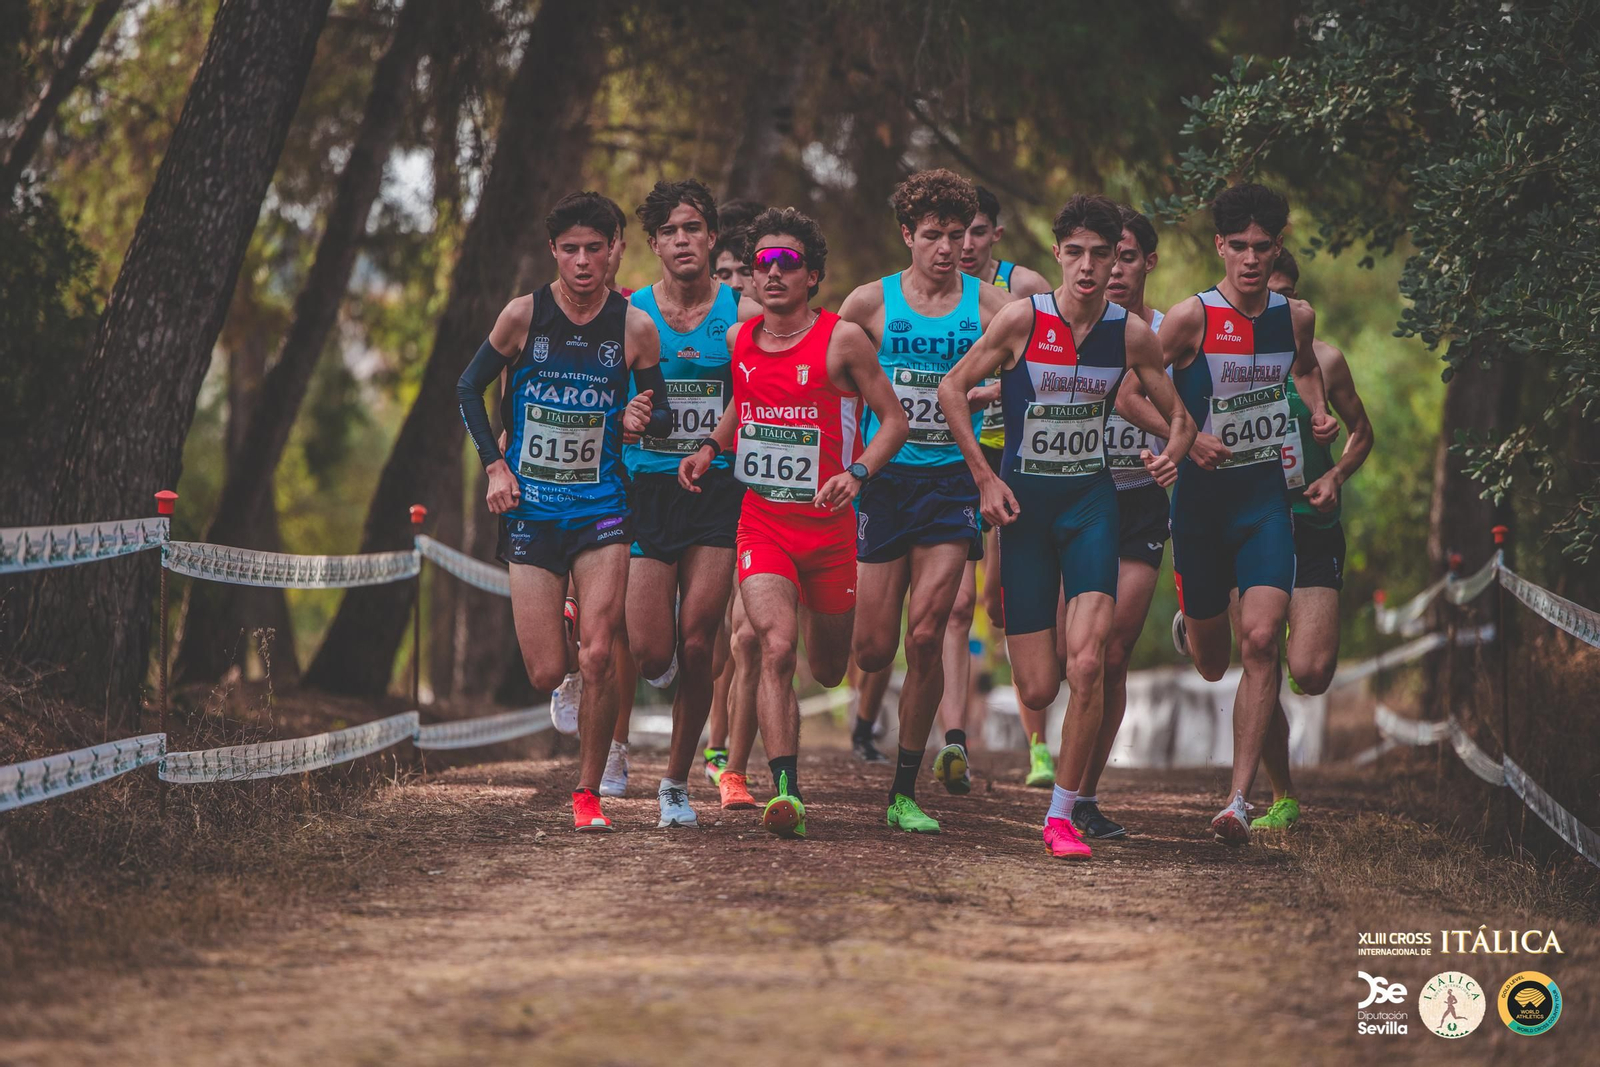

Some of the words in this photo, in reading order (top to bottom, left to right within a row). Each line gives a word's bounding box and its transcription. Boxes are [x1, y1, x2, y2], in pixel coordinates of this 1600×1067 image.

[890, 331, 974, 360] nerja
[1038, 342, 1064, 353] VIATOR
[1216, 334, 1242, 342] VIATOR
[538, 370, 560, 379] CLUB
[561, 372, 608, 384] ATLETISMO
[666, 382, 702, 393] TÁLICA
[917, 374, 942, 384] ITÁLI
[524, 379, 616, 408] NARÓN
[546, 411, 584, 424] ITÁLICA
[671, 408, 717, 433] 404
[755, 406, 819, 419] navarra
[899, 398, 947, 424] 828
[1050, 405, 1088, 416] ITÁLICA
[760, 427, 798, 440] ITÁLICA
[1105, 426, 1149, 449] 161
[1221, 412, 1287, 447] 6402
[528, 434, 596, 464] 6156
[1031, 428, 1099, 455] 6400
[743, 451, 812, 482] 6162
[1281, 446, 1297, 470] 5
